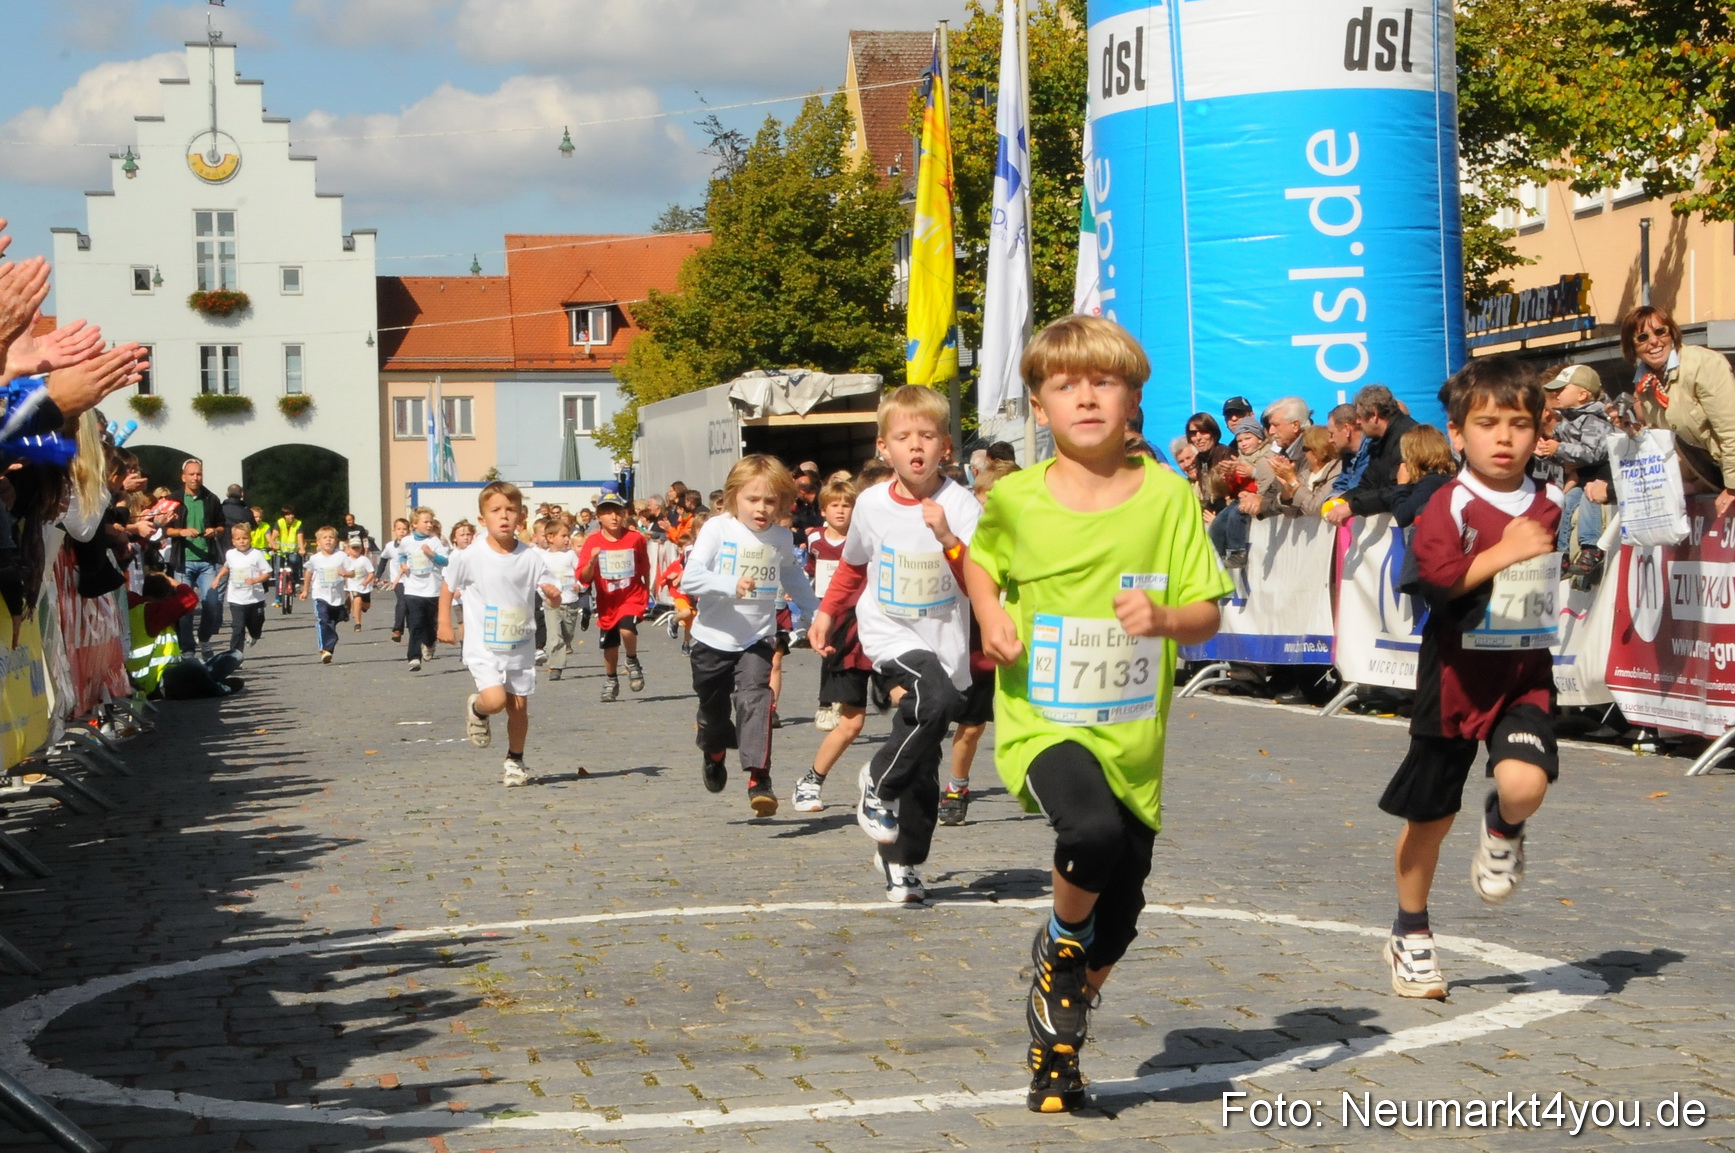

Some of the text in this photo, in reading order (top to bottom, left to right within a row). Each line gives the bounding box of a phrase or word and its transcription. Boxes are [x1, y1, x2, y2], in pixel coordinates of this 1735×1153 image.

[1343, 7, 1413, 73] dsl
[1102, 26, 1146, 100] dsl
[742, 548, 764, 560] Josef
[898, 555, 940, 570] Thomas
[740, 565, 776, 581] 7298
[900, 574, 952, 596] 7128
[1673, 574, 1692, 605] ZU
[1069, 627, 1100, 648] Jan
[1036, 656, 1052, 672] K2
[1070, 657, 1149, 690] 7133
[1369, 659, 1416, 676] MICRO COM
